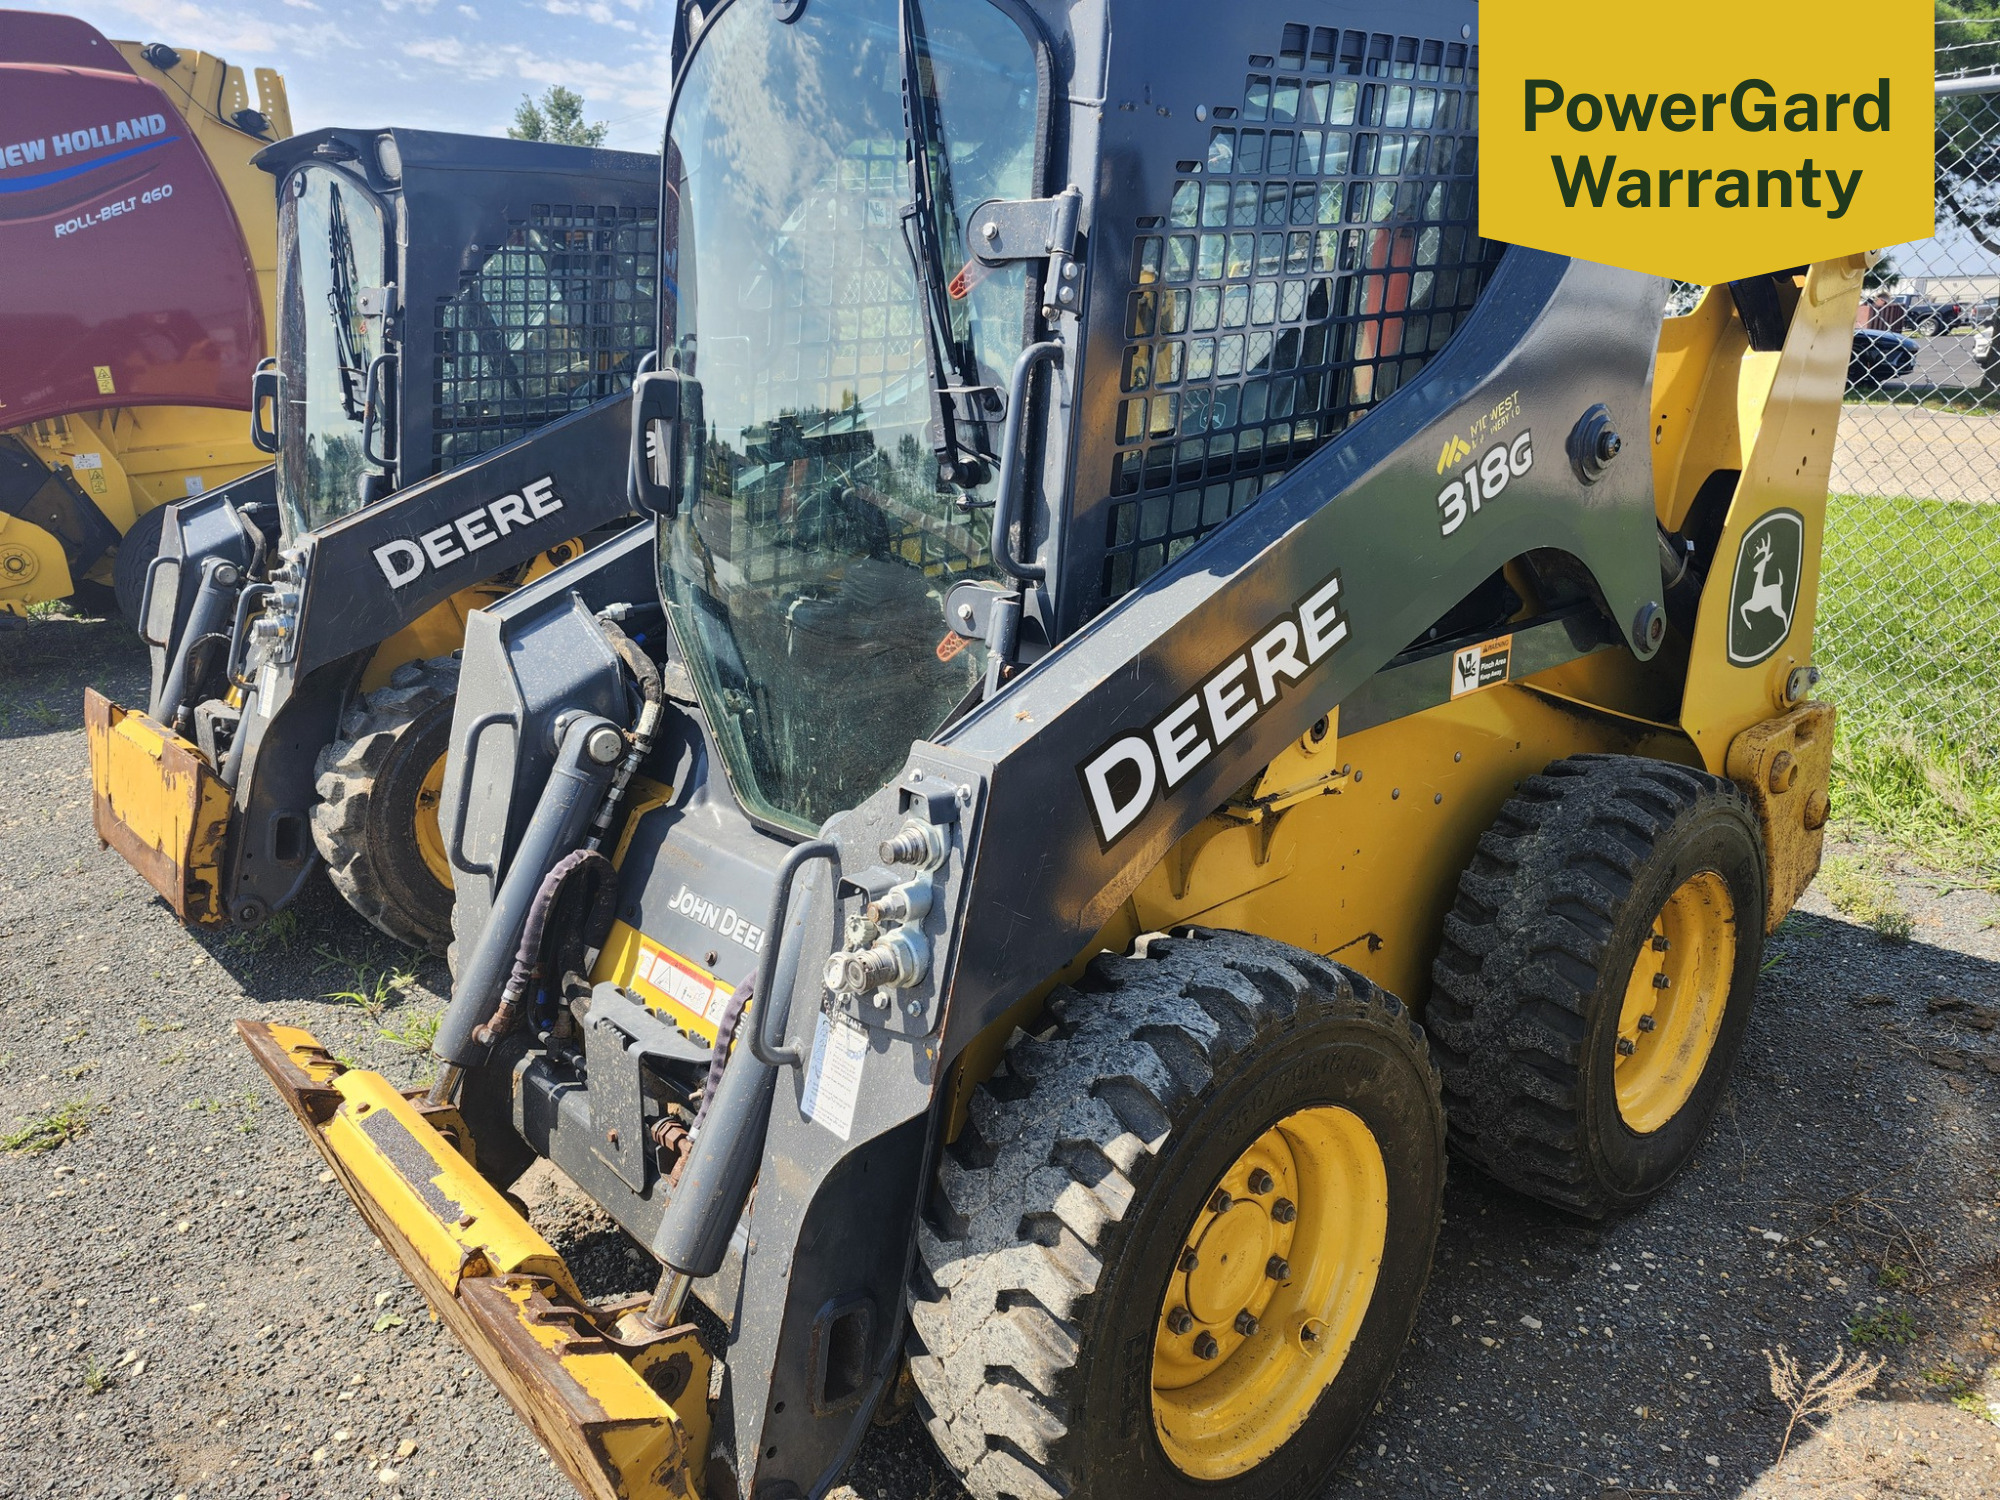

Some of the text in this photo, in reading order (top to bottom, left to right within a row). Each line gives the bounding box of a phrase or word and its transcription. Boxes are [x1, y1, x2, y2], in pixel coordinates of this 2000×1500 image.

[52, 113, 166, 157] HOLLAND
[54, 184, 173, 238] ROLL-BELT 460
[1438, 430, 1533, 536] 318G
[373, 476, 563, 589] DEERE
[1480, 658, 1507, 671] Pinch Area
[1084, 577, 1347, 842] DEERE
[668, 884, 766, 954] JOHN DEE
